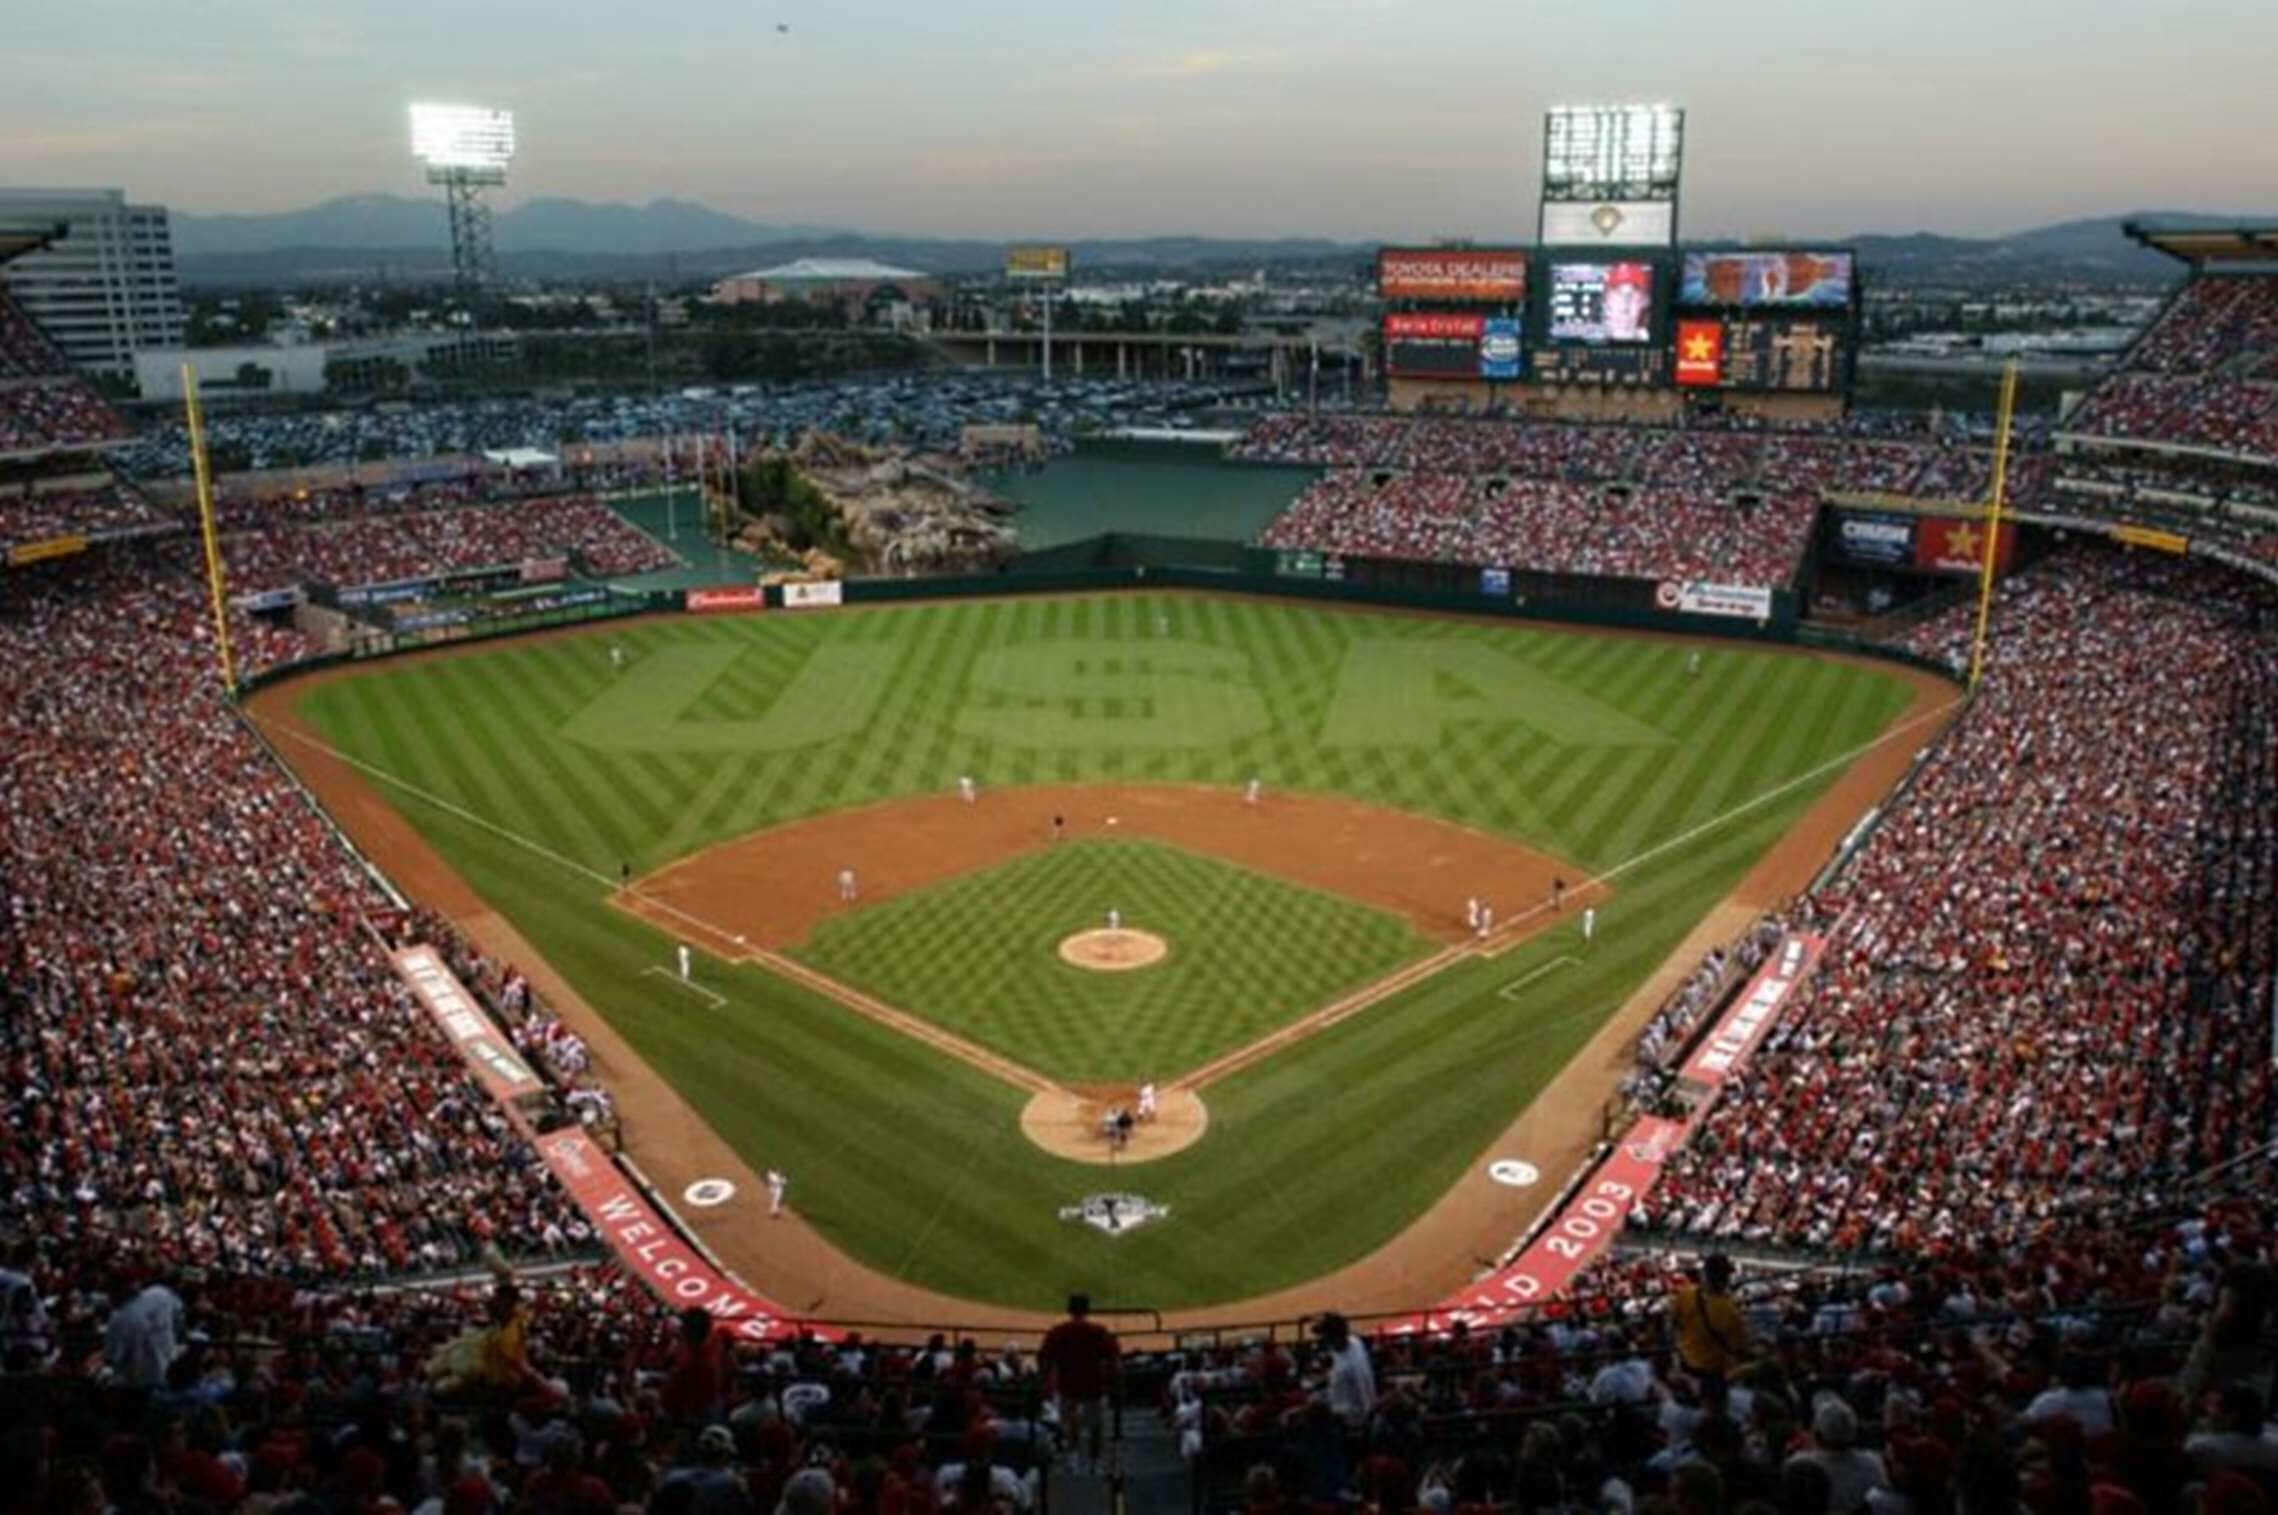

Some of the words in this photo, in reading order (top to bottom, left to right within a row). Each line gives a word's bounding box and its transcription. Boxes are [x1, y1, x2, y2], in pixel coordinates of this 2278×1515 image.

[1381, 261, 1443, 278] TOYOTA
[553, 638, 1680, 752] USA
[1546, 1180, 1632, 1259] 2003
